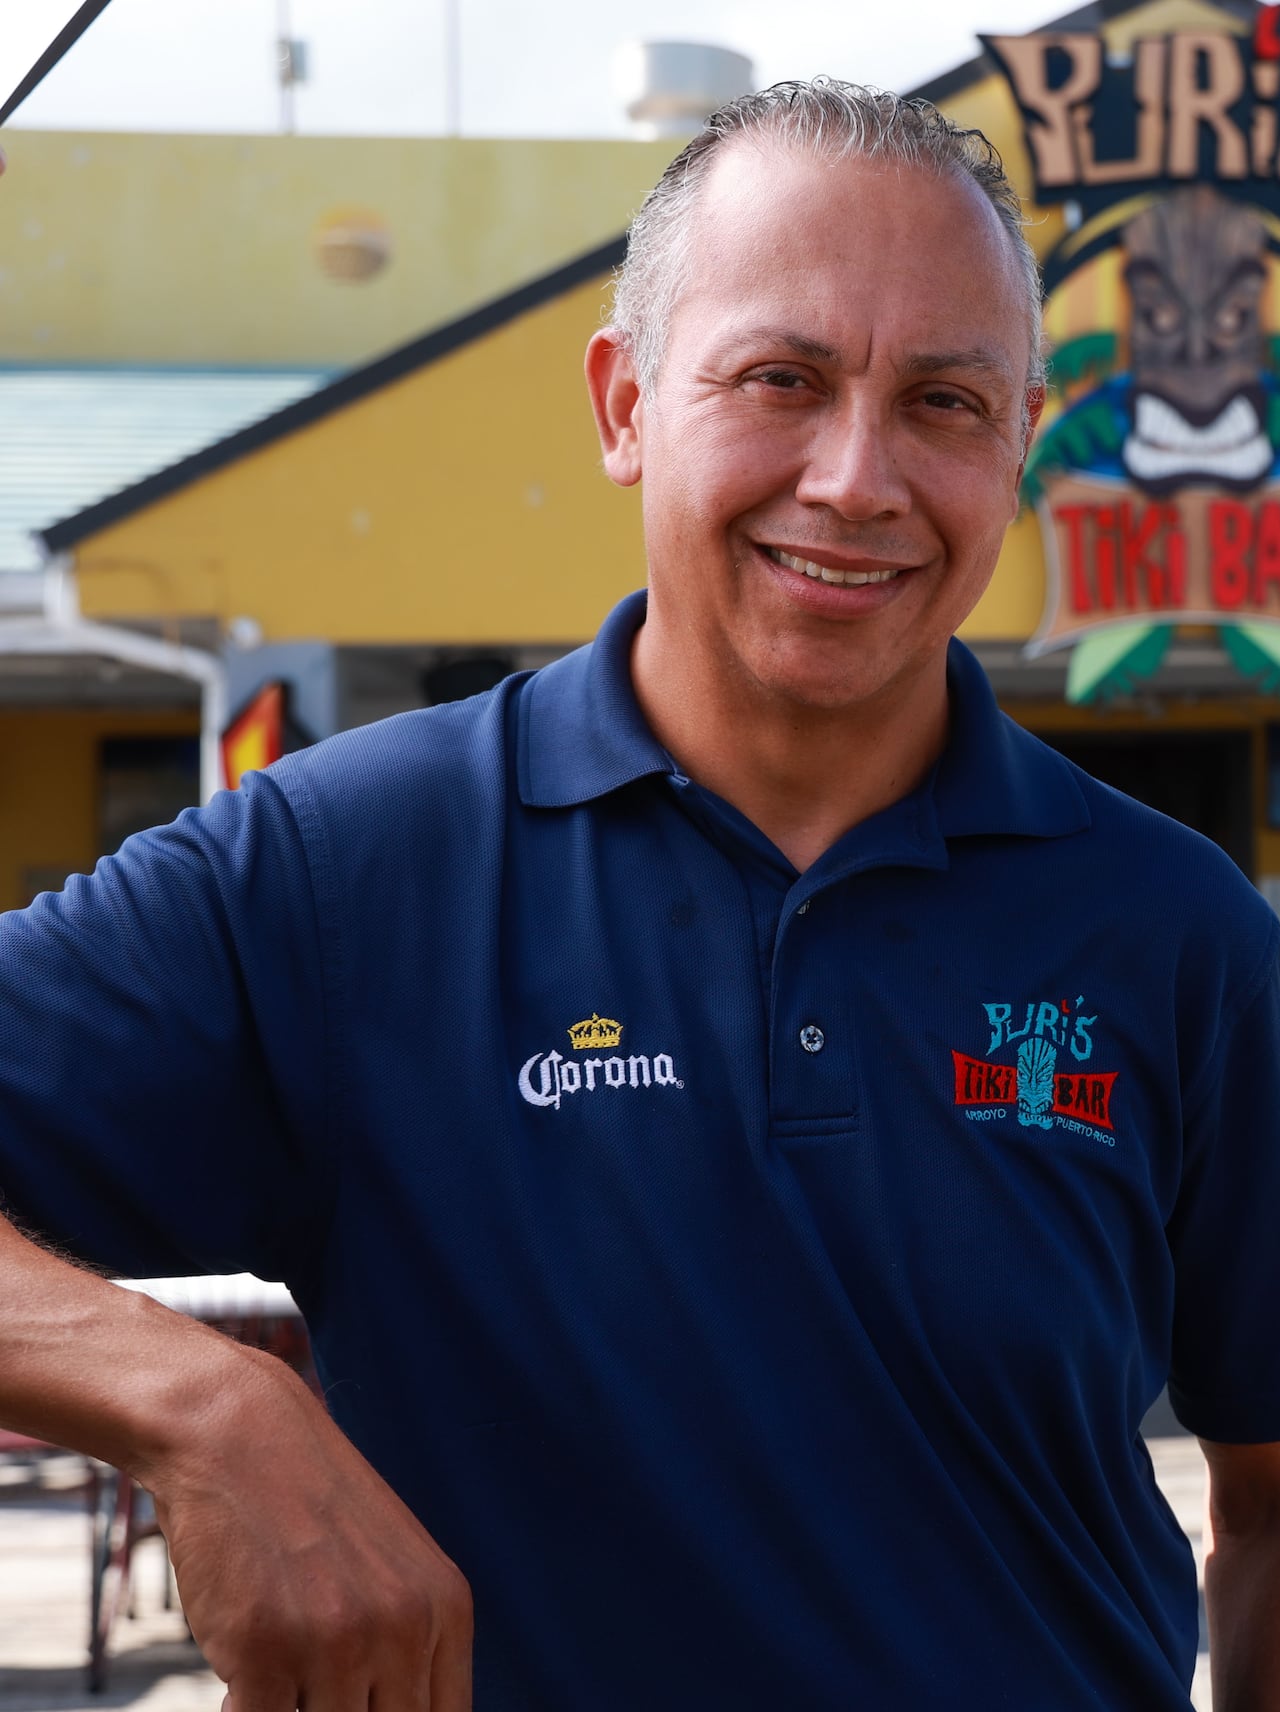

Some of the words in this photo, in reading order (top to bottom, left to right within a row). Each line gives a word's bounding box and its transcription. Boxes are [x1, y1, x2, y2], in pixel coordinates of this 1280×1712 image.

[518, 1050, 678, 1110] Corona
[1058, 1077, 1106, 1120] BAR
[965, 1108, 1007, 1121] ARROYO
[1056, 1115, 1093, 1138] PUERTO
